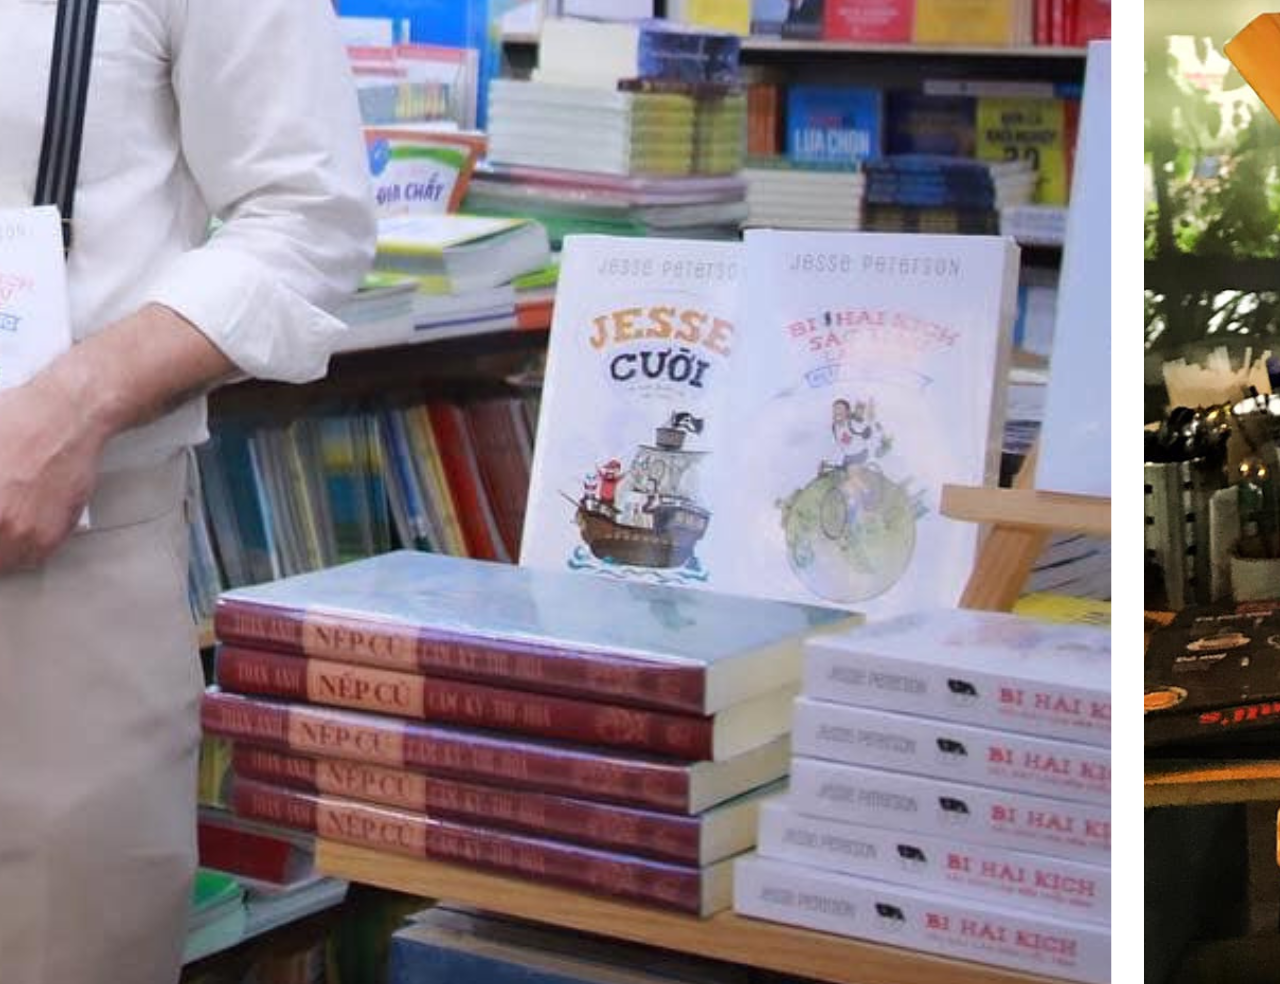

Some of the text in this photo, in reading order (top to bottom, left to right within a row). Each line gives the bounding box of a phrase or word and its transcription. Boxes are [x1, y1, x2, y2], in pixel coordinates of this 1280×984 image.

[588, 304, 737, 358] JESSE
[321, 666, 374, 704] NẾP
[996, 686, 1024, 706] BI
[988, 746, 1015, 765] BI
[947, 852, 972, 872] BI
[925, 912, 950, 932] BI
